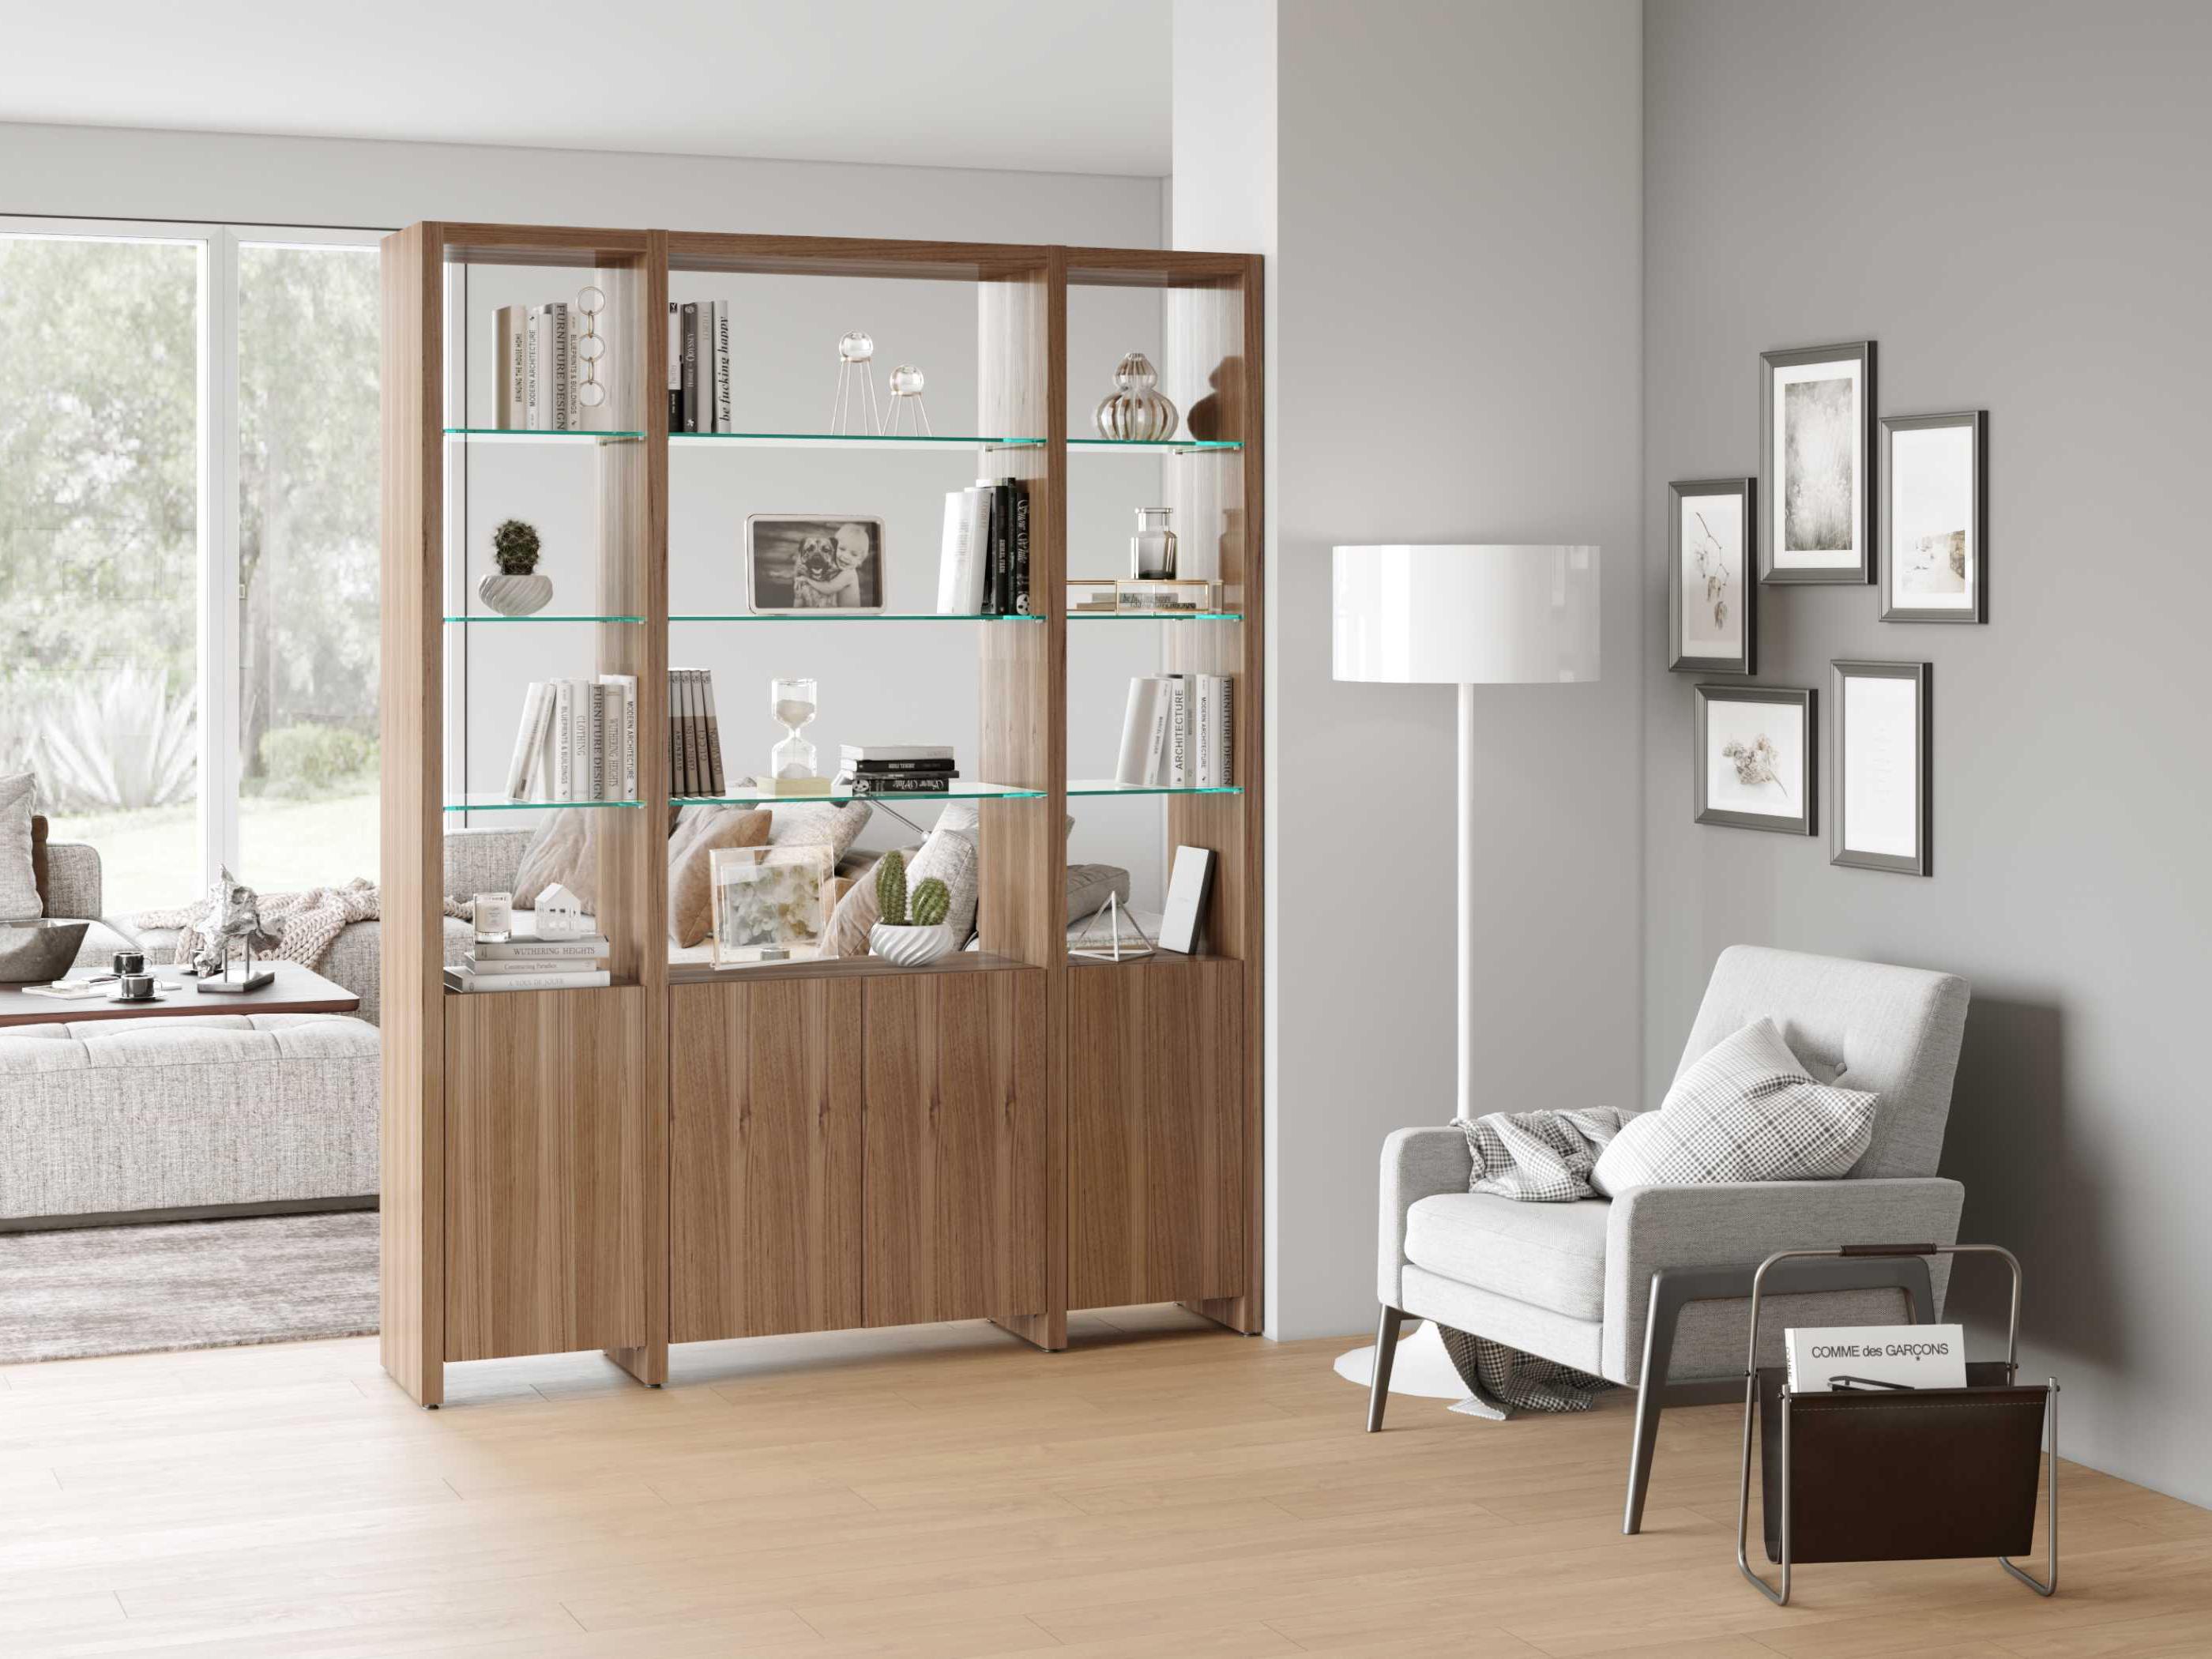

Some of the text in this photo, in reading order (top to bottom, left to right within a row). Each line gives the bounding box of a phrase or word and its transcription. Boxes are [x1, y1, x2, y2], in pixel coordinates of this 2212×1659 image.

[556, 304, 566, 431] FURNITURE DESIGN
[717, 316, 730, 422] be fucking happy
[576, 715, 586, 756] CLOTHING
[593, 686, 603, 800] FURNITURE DESIGN
[1175, 689, 1183, 770] ARCHITECTURE
[1811, 1345, 1860, 1358] COMME
[1862, 1345, 1883, 1356] des
